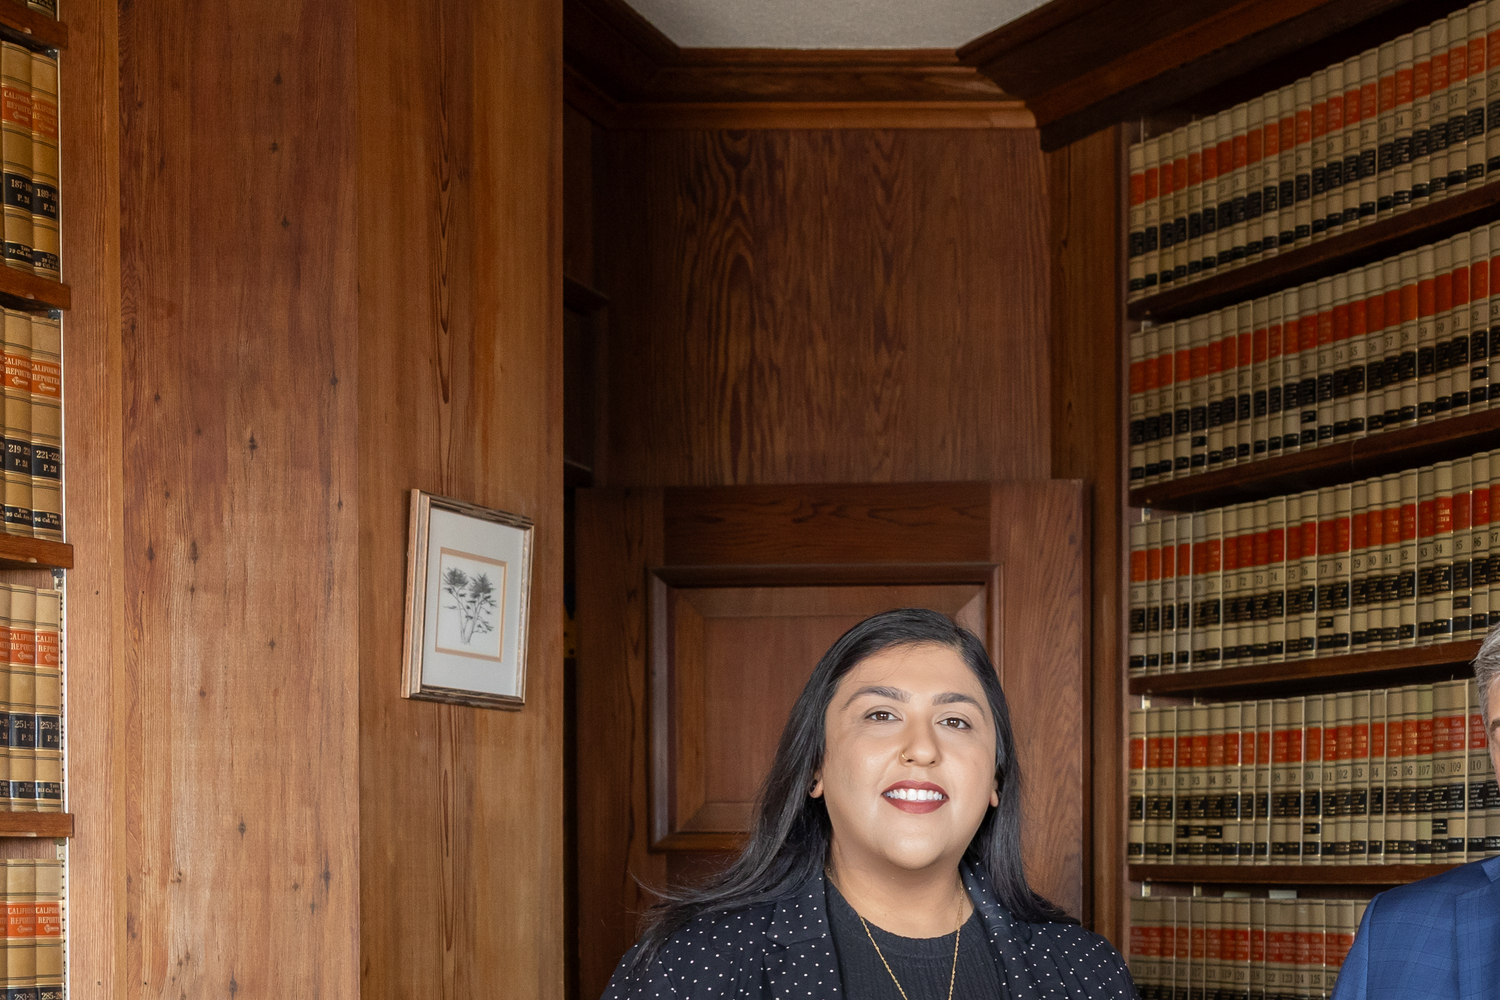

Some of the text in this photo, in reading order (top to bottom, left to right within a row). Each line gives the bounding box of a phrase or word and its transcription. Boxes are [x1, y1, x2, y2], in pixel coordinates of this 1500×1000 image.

[1474, 537, 1481, 547] 86
[1491, 532, 1498, 542] 87
[1435, 544, 1442, 554] 84
[1354, 559, 1360, 569] 79
[1384, 554, 1392, 564] 81
